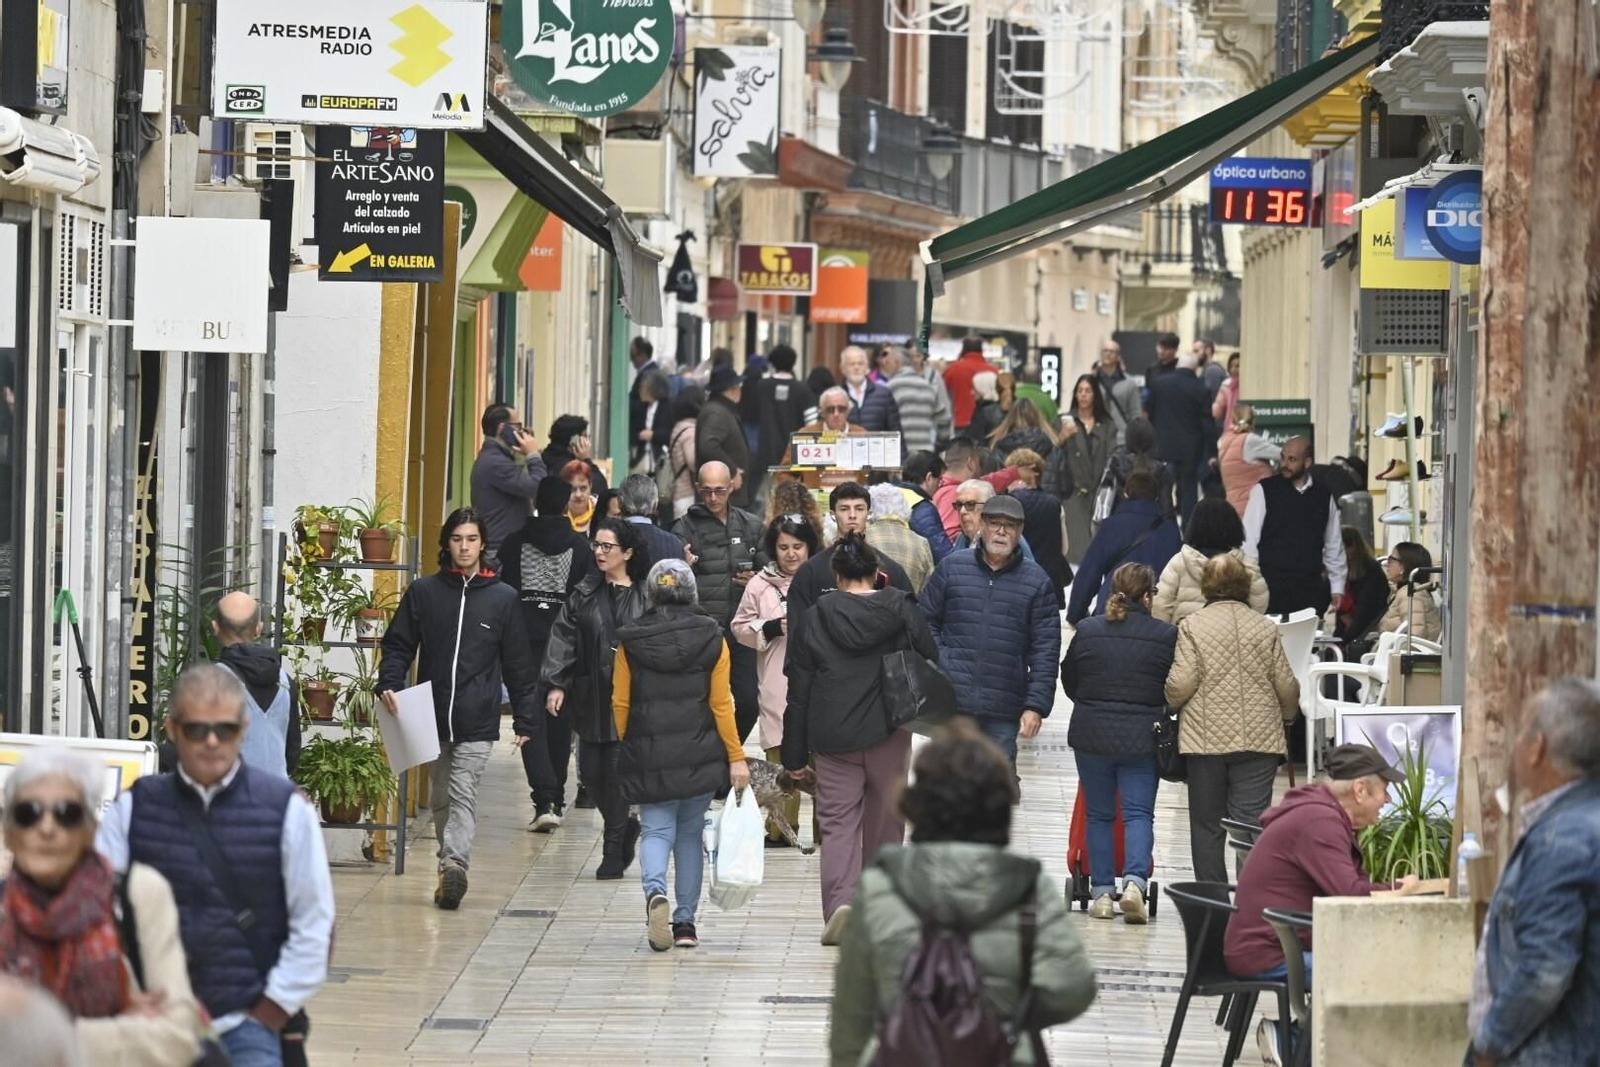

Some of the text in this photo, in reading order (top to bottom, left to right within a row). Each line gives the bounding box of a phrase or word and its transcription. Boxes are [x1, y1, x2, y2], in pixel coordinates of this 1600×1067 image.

[248, 23, 372, 41] ATRESMEDIA
[320, 42, 373, 56] RADIO
[233, 100, 258, 108] CERO
[549, 92, 629, 112] Fundada en 1915
[333, 149, 353, 162] EL
[331, 162, 434, 183] ARTESANO
[1213, 164, 1306, 180] óptica urbano
[345, 190, 419, 204] Arreglo y venta
[354, 206, 410, 218] del calzado
[343, 221, 421, 236] Artículos en piel
[1372, 231, 1395, 247] MÁ
[370, 255, 435, 268] EN GALERIA
[741, 272, 810, 289] TABACOS
[1272, 403, 1307, 415] SABORES
